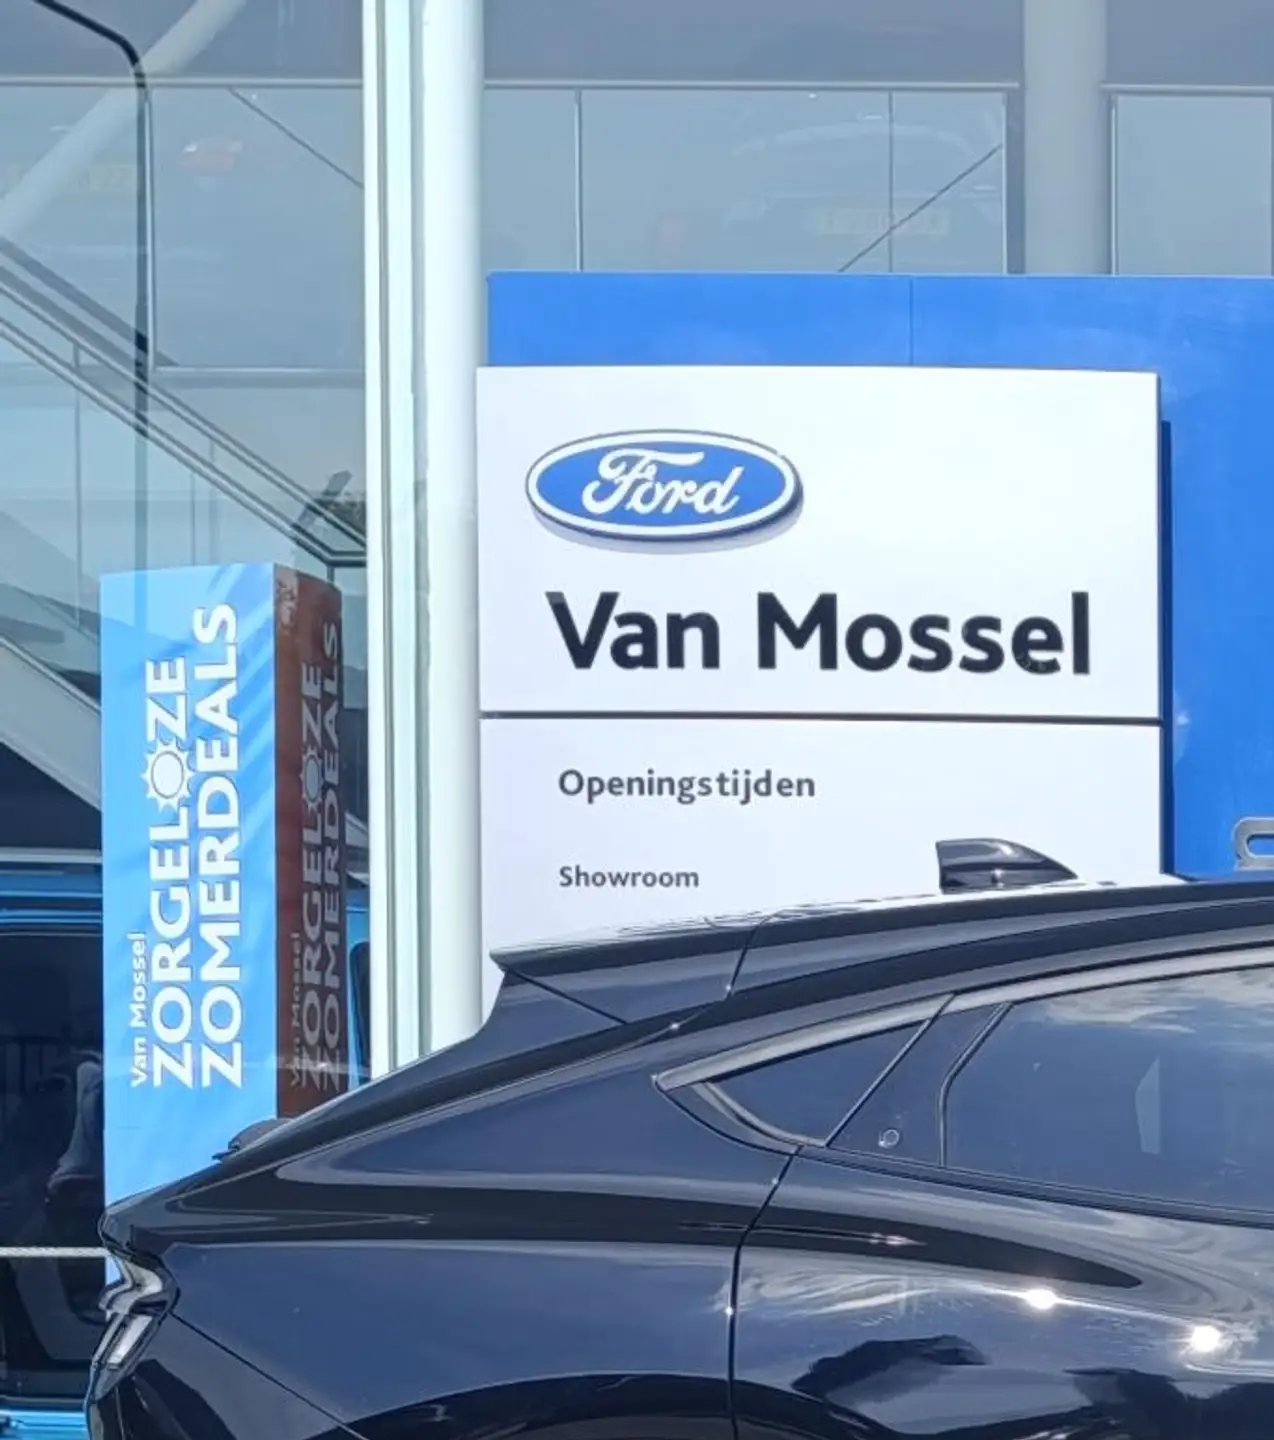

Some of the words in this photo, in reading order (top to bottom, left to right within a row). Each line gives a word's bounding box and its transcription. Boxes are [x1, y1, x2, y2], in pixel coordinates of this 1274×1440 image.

[582, 448, 744, 514] Ford
[544, 591, 720, 670] Van
[757, 591, 1090, 675] Mossel
[558, 769, 816, 805] Openingstijden
[193, 604, 243, 1088] ZOMERDEALS
[324, 622, 340, 1091] ZOMERDEALS
[558, 865, 700, 888] Showroom
[127, 932, 148, 1028] Mossel
[130, 1036, 149, 1087] Van
